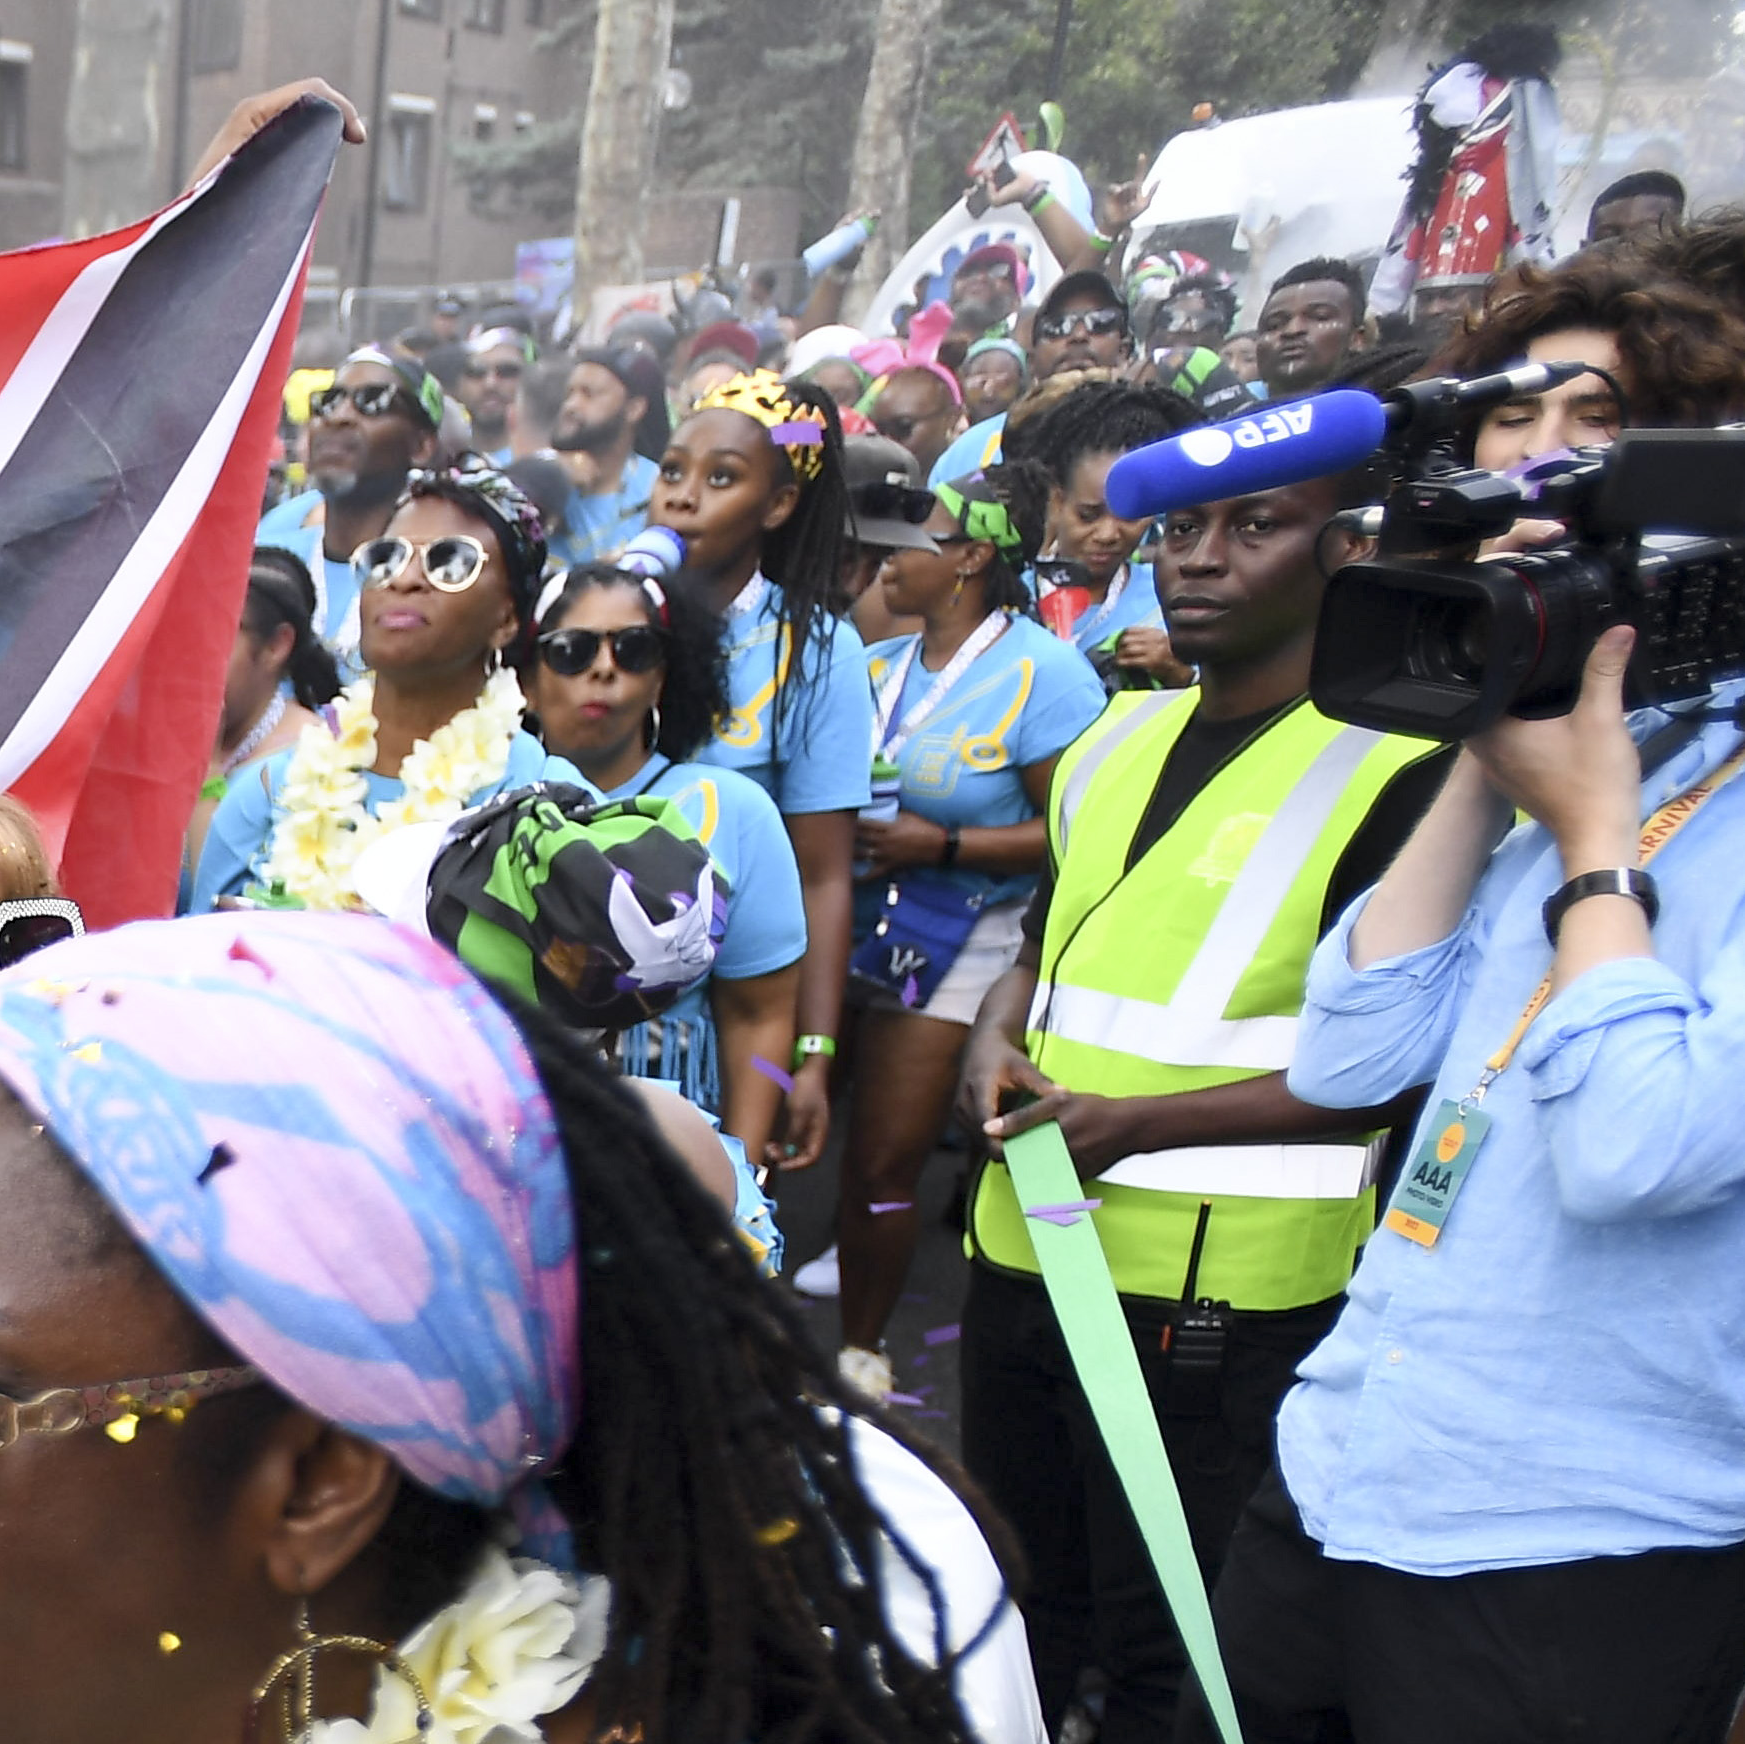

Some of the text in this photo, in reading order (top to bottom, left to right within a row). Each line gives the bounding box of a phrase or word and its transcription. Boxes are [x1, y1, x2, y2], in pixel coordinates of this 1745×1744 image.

[1233, 403, 1313, 448] AFP
[1638, 785, 1713, 862] ARNIVAL
[1412, 1161, 1453, 1195] AAA
